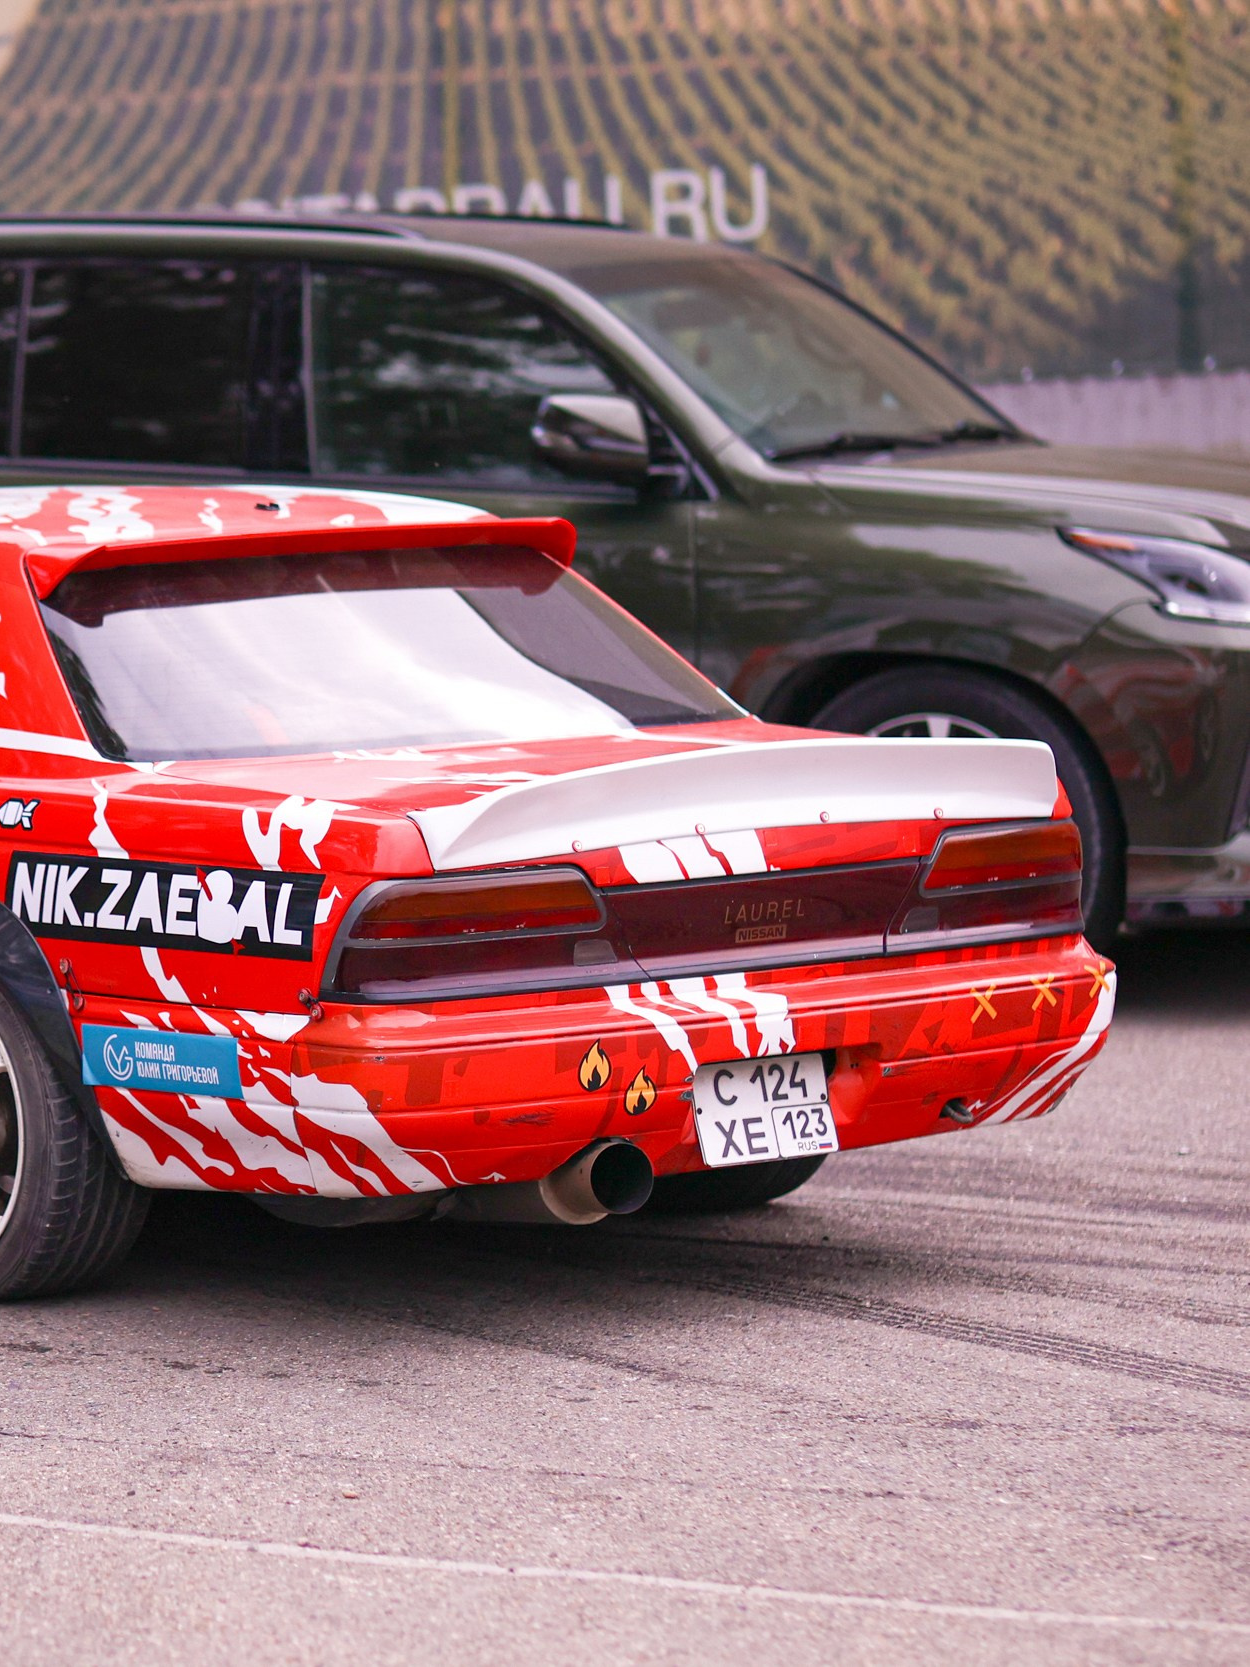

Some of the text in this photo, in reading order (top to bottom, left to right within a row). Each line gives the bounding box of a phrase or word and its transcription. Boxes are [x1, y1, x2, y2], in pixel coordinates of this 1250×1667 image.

[724, 898, 805, 924] LAUREL
[737, 926, 785, 941] NISSAN
[134, 1041, 176, 1062] КОМАНДА
[136, 1061, 220, 1085] ЮЛИИ ГРИГОРЬЕВОЙ
[749, 1061, 808, 1103] 124
[781, 1108, 828, 1140] 123
[797, 1140, 818, 1152] RUS
